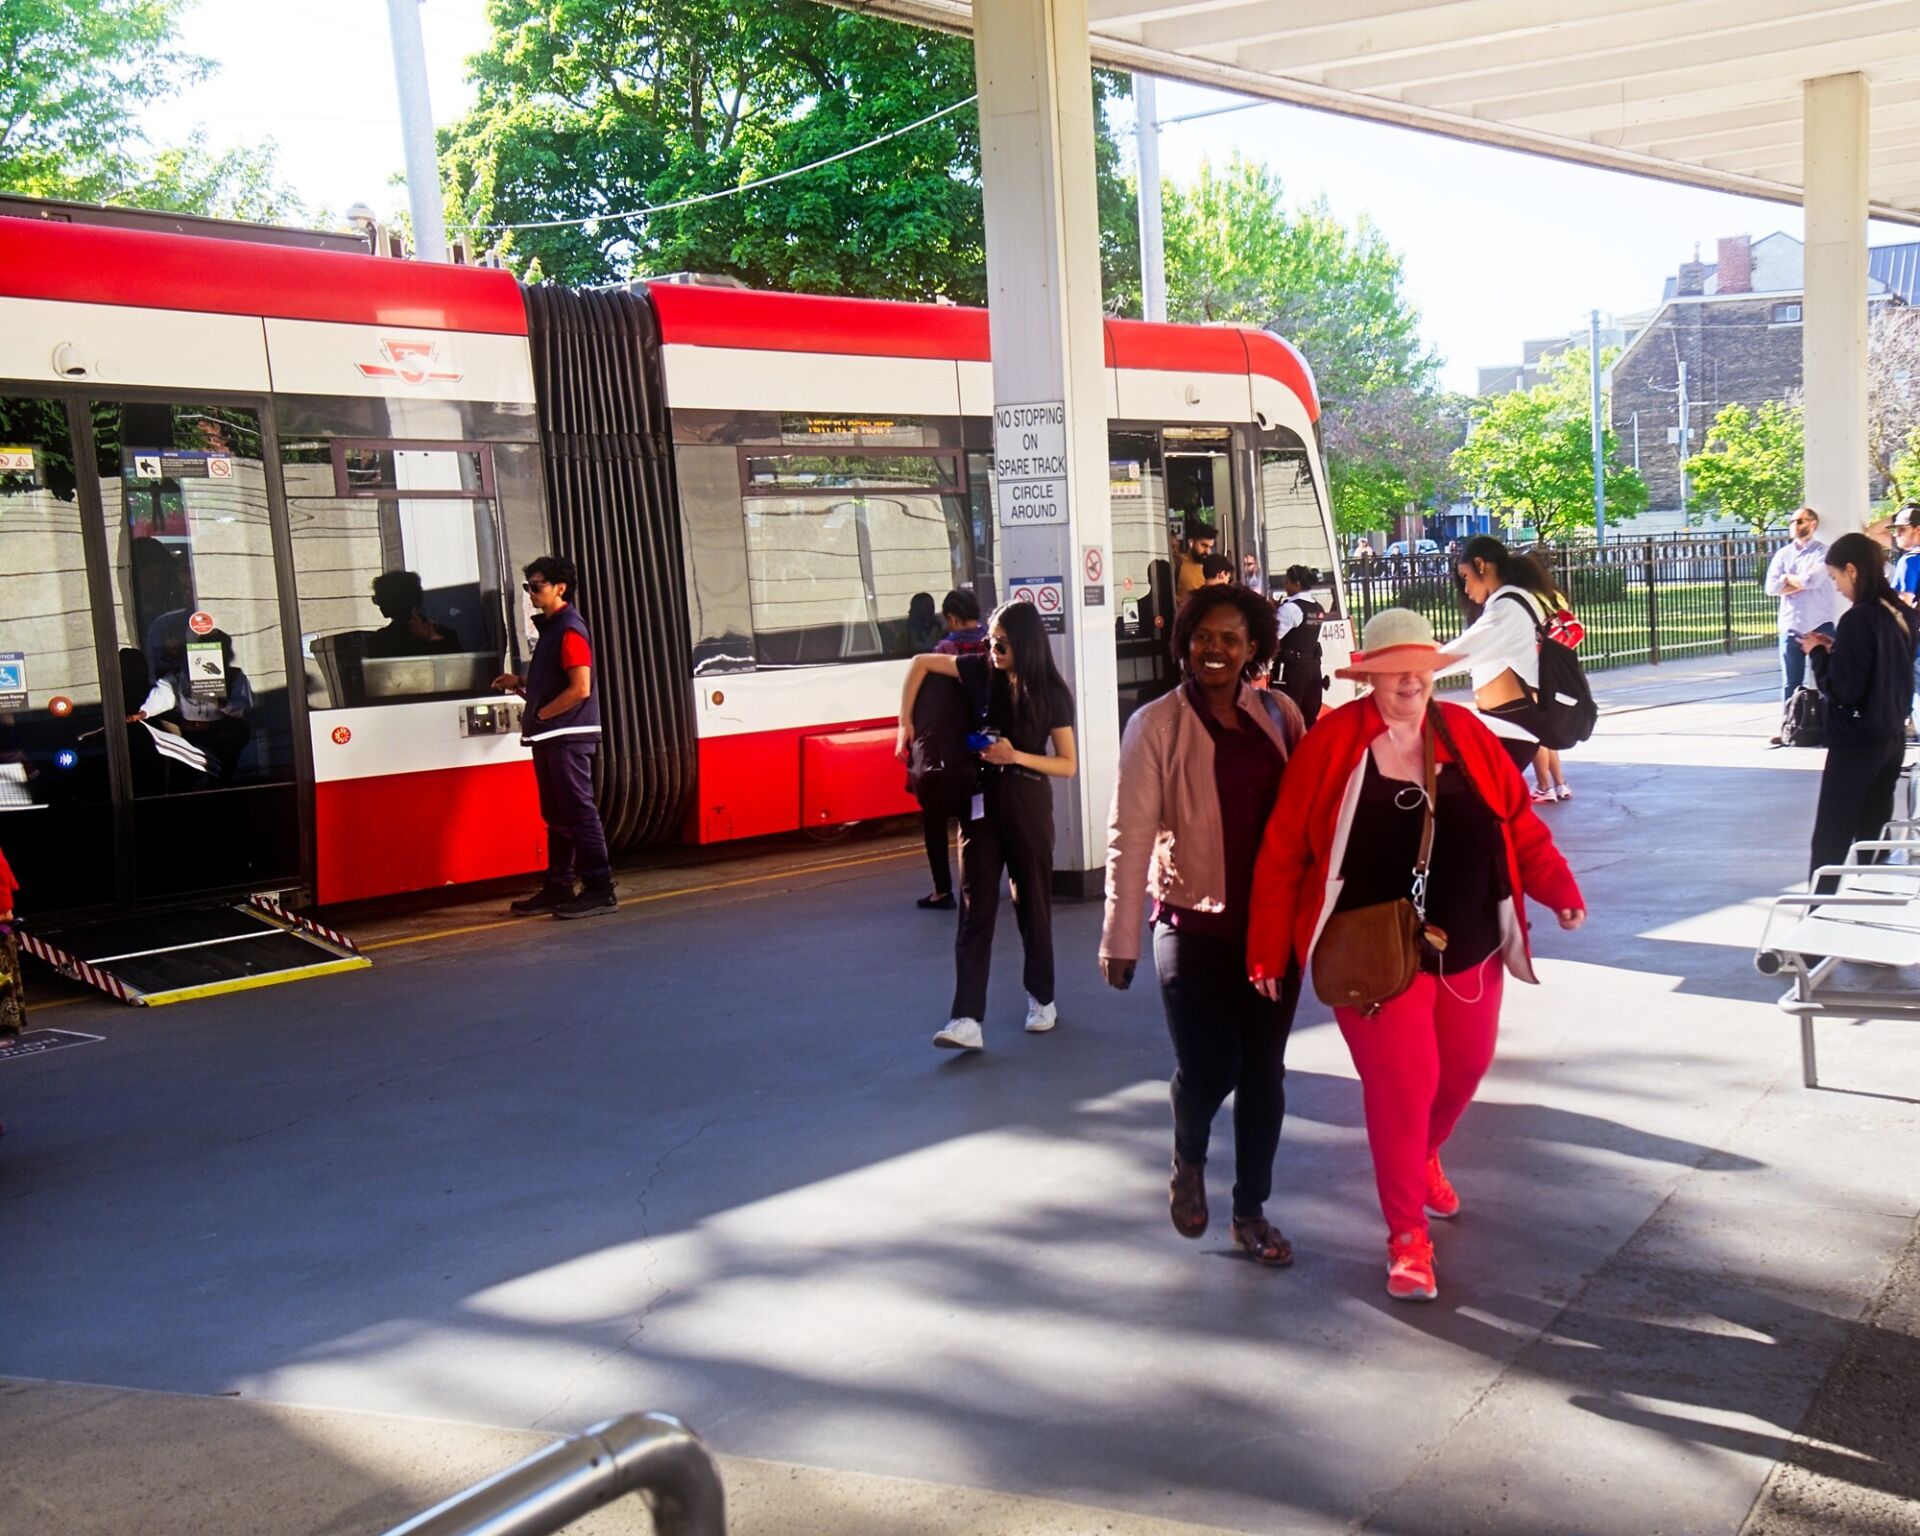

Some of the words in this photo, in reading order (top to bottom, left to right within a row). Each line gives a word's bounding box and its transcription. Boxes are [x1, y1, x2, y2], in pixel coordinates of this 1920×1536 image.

[997, 410, 1011, 428] NO
[1014, 407, 1063, 428] STOPPING
[1023, 433, 1038, 451] ON
[999, 458, 1029, 476] SPARE
[1032, 456, 1065, 474] TRACK
[1012, 485, 1053, 500] CIRCLE
[1011, 503, 1057, 519] AROUND
[1322, 623, 1345, 640] 4485
